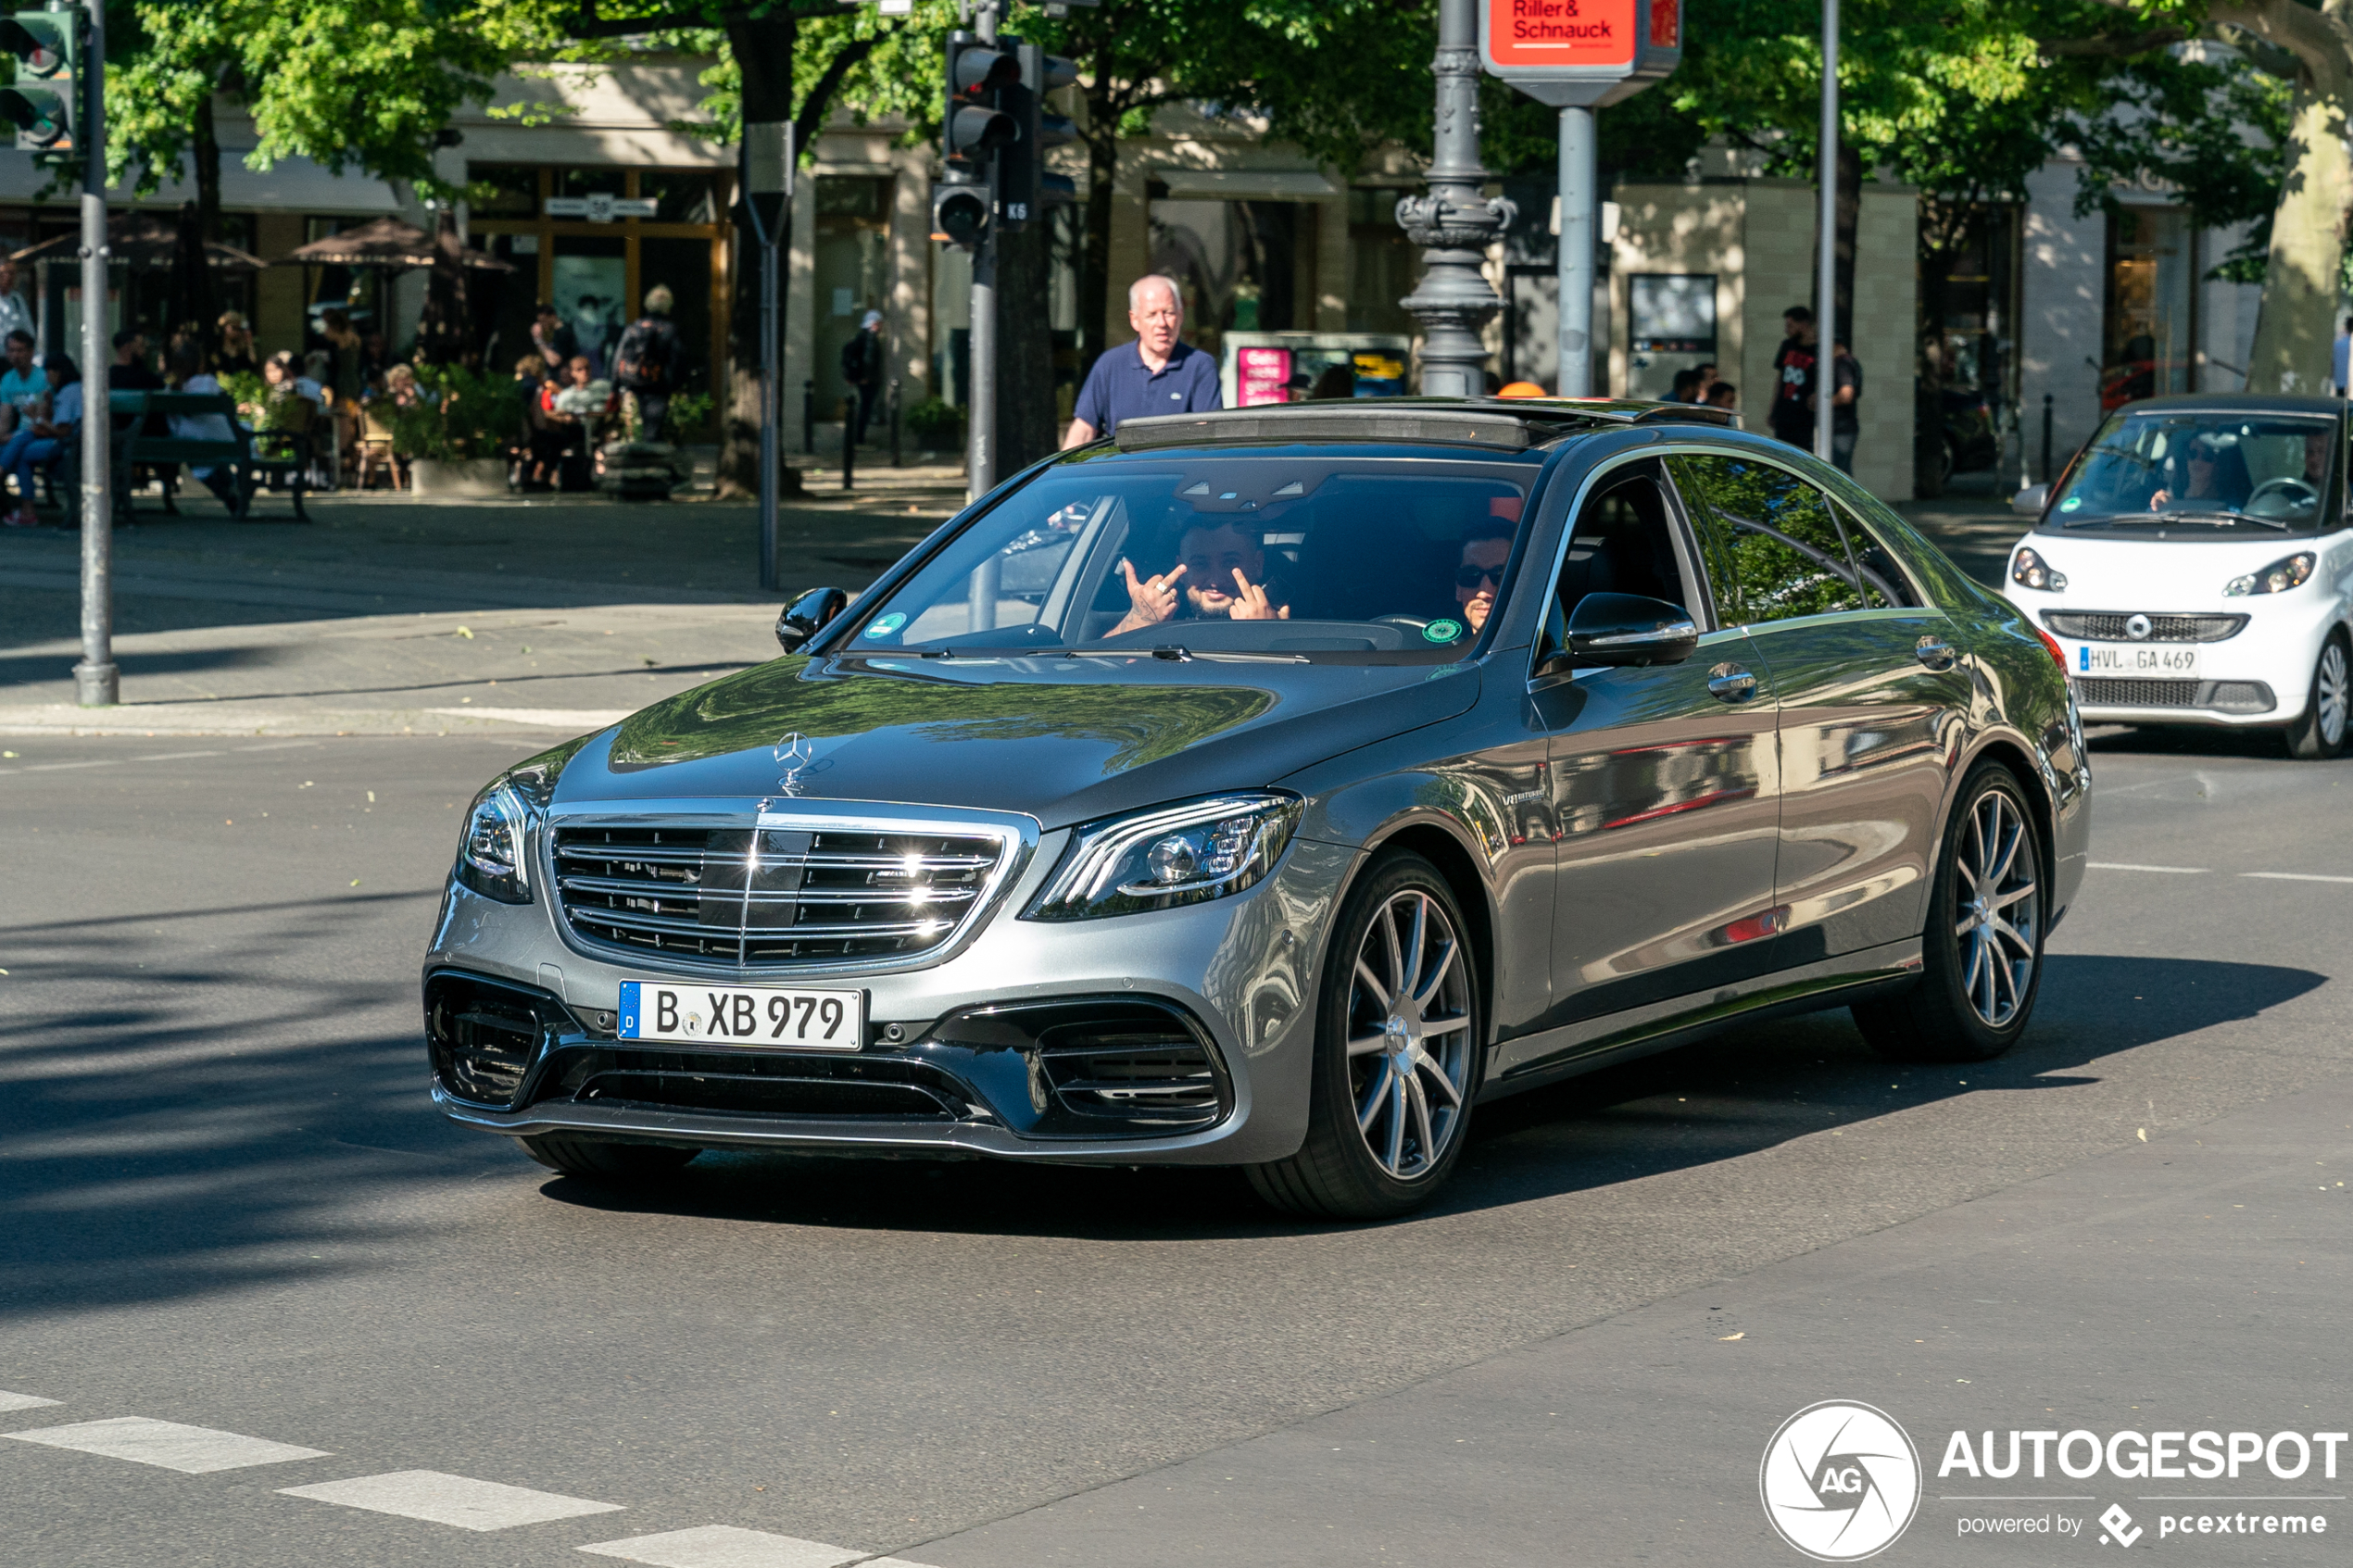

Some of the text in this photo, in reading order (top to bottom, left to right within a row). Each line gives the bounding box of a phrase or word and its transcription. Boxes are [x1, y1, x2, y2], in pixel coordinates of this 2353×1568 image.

[1514, 0, 1579, 17] Riller &
[1514, 20, 1612, 38] Schnauck
[2091, 650, 2121, 669] HVL
[2137, 651, 2158, 669] GA
[2163, 651, 2195, 669] 469
[625, 990, 843, 1039] D B XB 979
